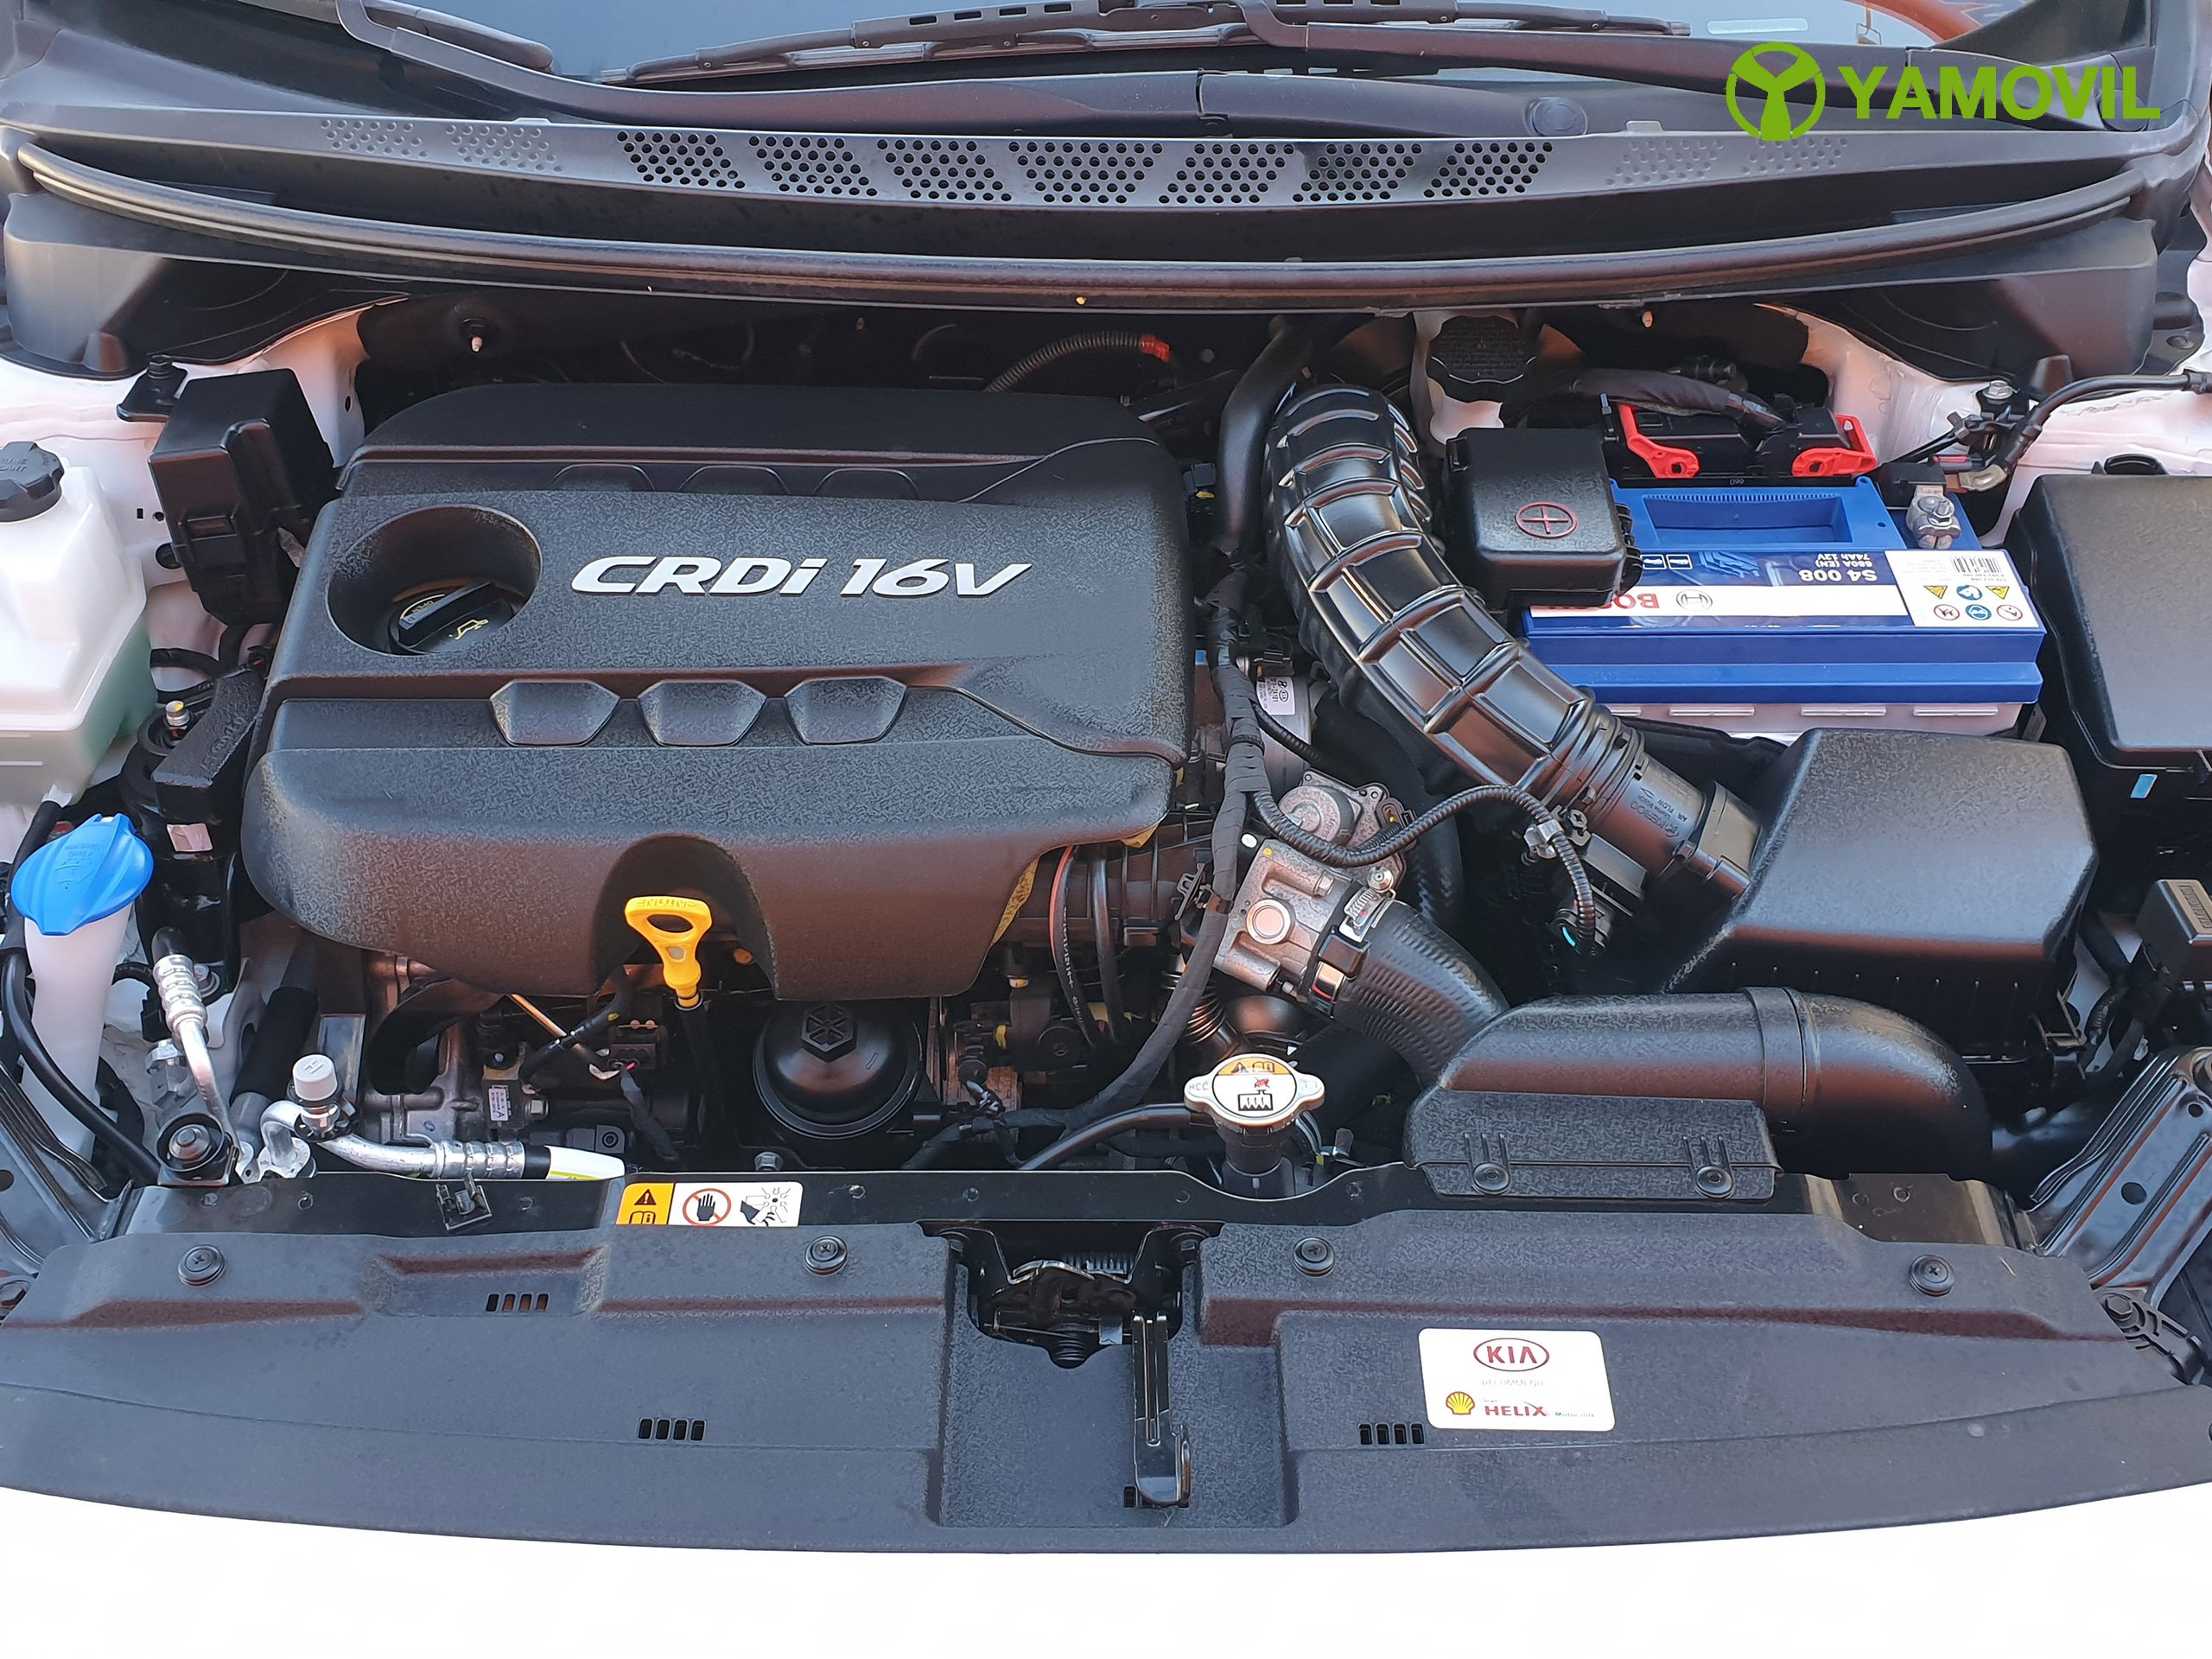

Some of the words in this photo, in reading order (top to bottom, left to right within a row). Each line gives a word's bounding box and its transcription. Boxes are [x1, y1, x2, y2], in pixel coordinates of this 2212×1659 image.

[570, 556, 828, 596] CRDi
[840, 558, 1033, 597] 16V
[1798, 569, 1842, 582] 008
[1847, 569, 1878, 582] S4
[1188, 1082, 1209, 1091] HCC
[1486, 1345, 1538, 1363] KIA
[1484, 1404, 1548, 1417] HELIX
